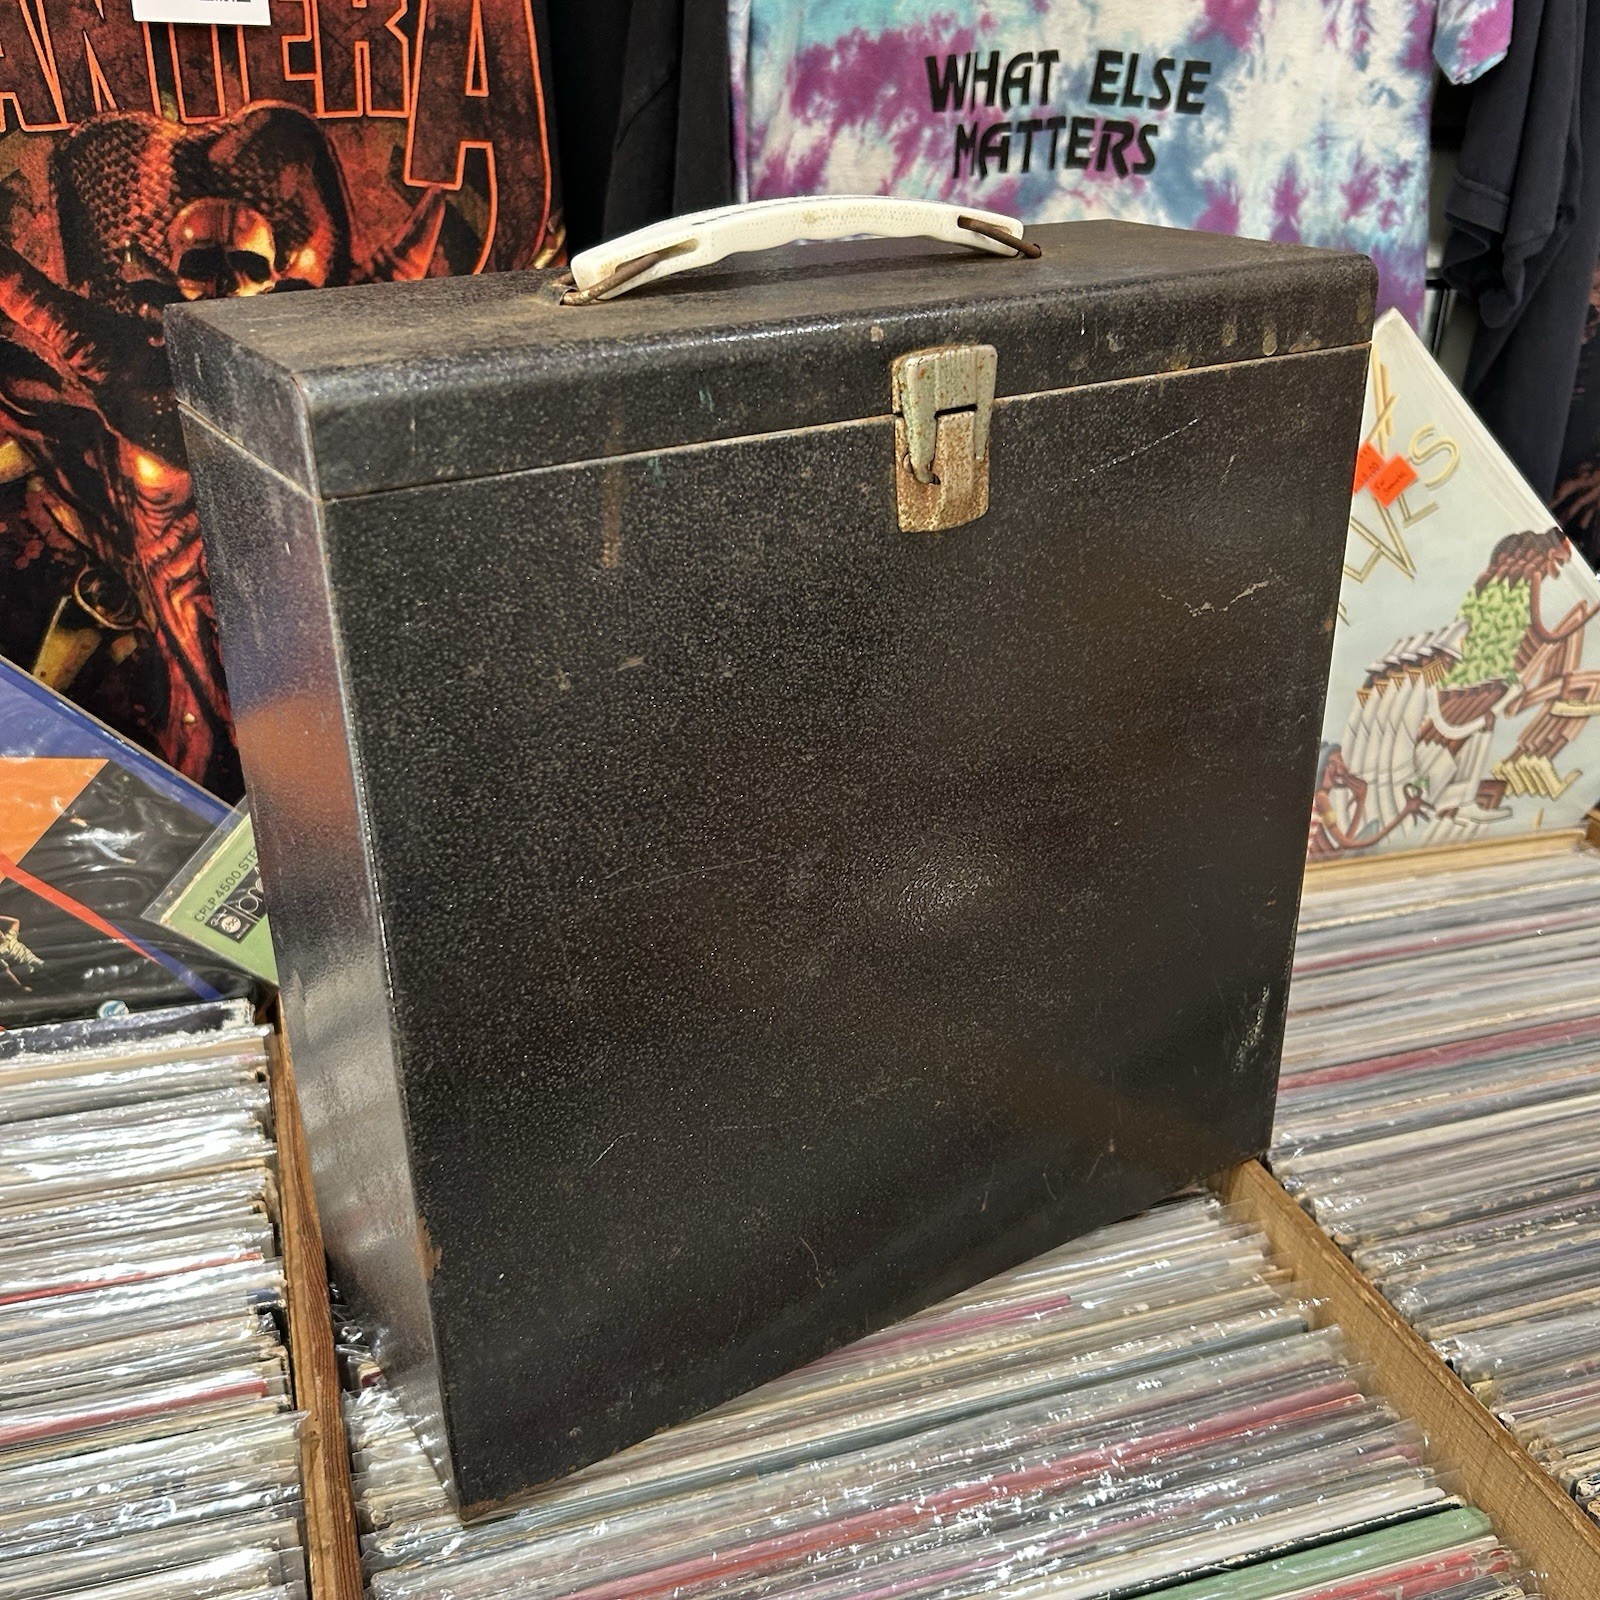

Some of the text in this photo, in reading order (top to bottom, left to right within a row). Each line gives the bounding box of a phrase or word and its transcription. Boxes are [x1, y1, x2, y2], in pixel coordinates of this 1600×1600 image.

[924, 49, 1212, 115] WHAT ELSE
[952, 116, 1159, 180] MATTERS
[194, 846, 258, 922] CPLP 4500 STE
